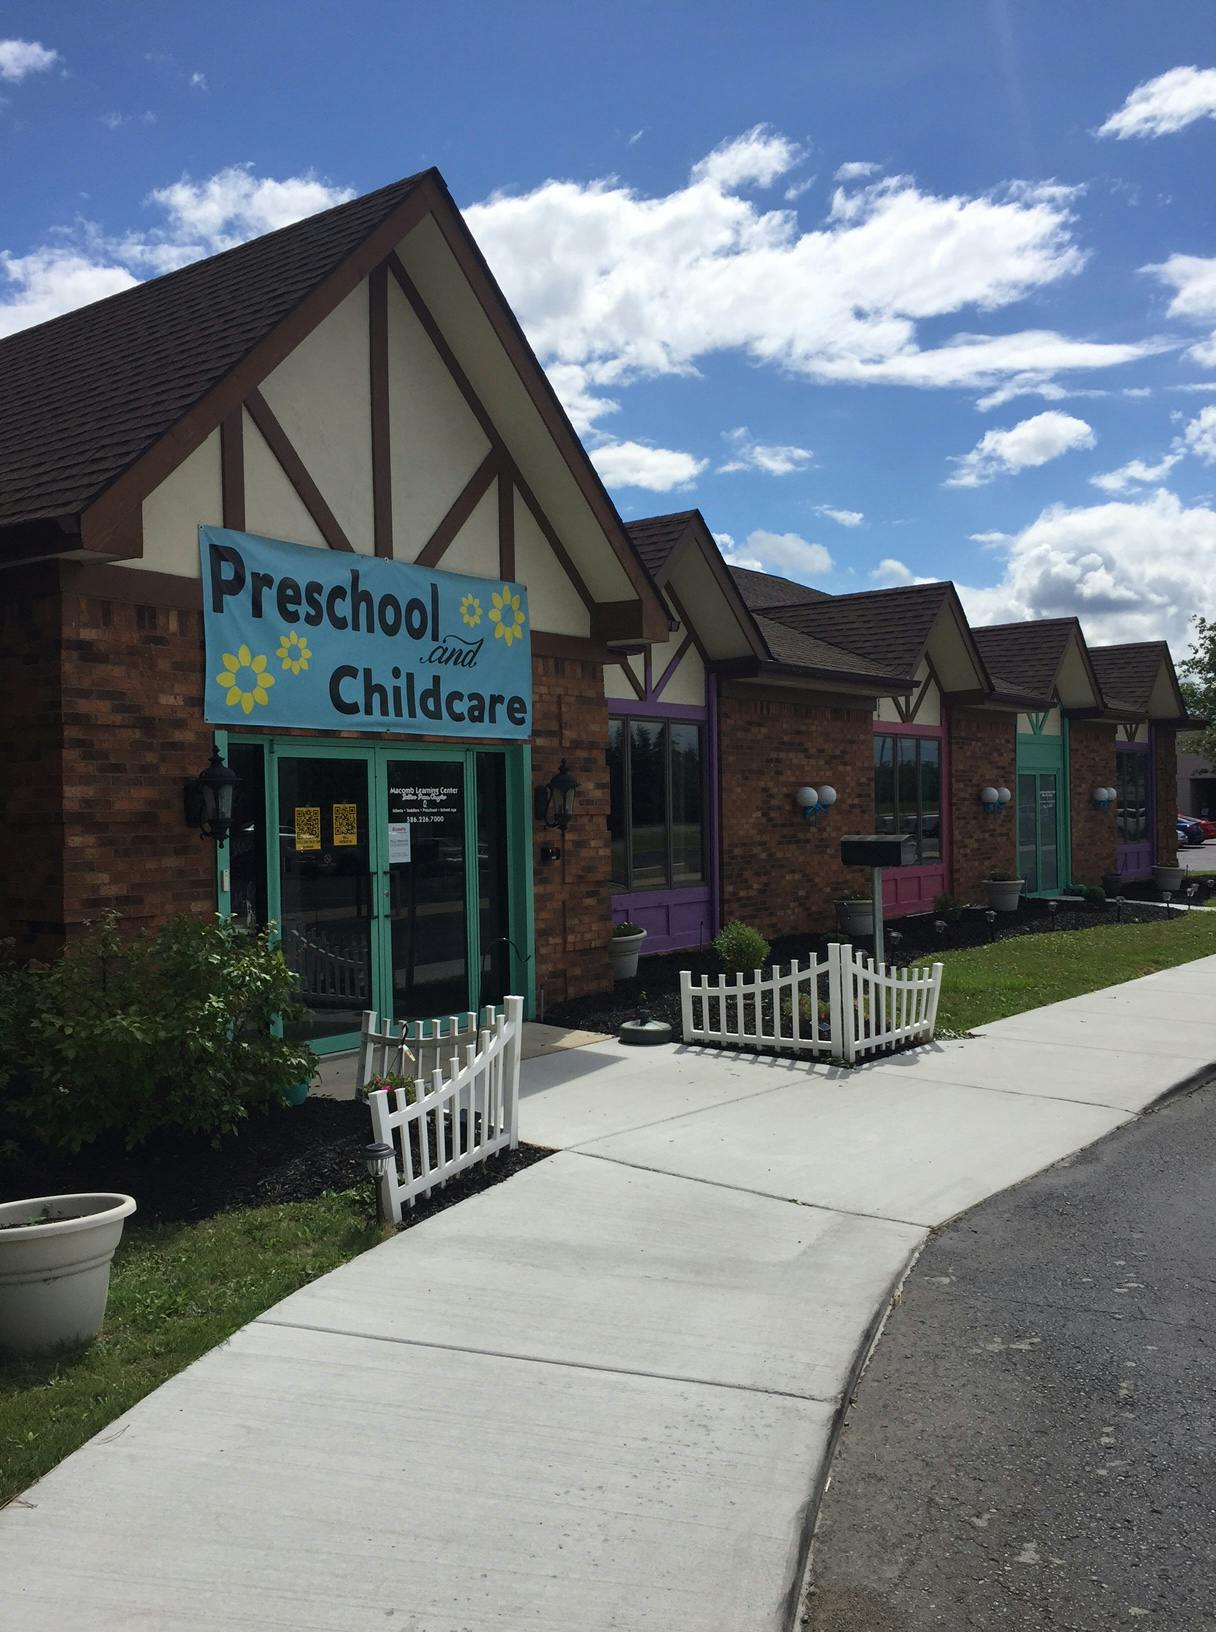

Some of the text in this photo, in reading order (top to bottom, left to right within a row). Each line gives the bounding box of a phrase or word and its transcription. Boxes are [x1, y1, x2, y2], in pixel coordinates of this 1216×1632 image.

[209, 543, 440, 642] Preschool
[420, 634, 484, 667] and
[329, 664, 528, 726] Childcare
[415, 787, 439, 795] Learning
[406, 815, 445, 823] 586.226.7000
